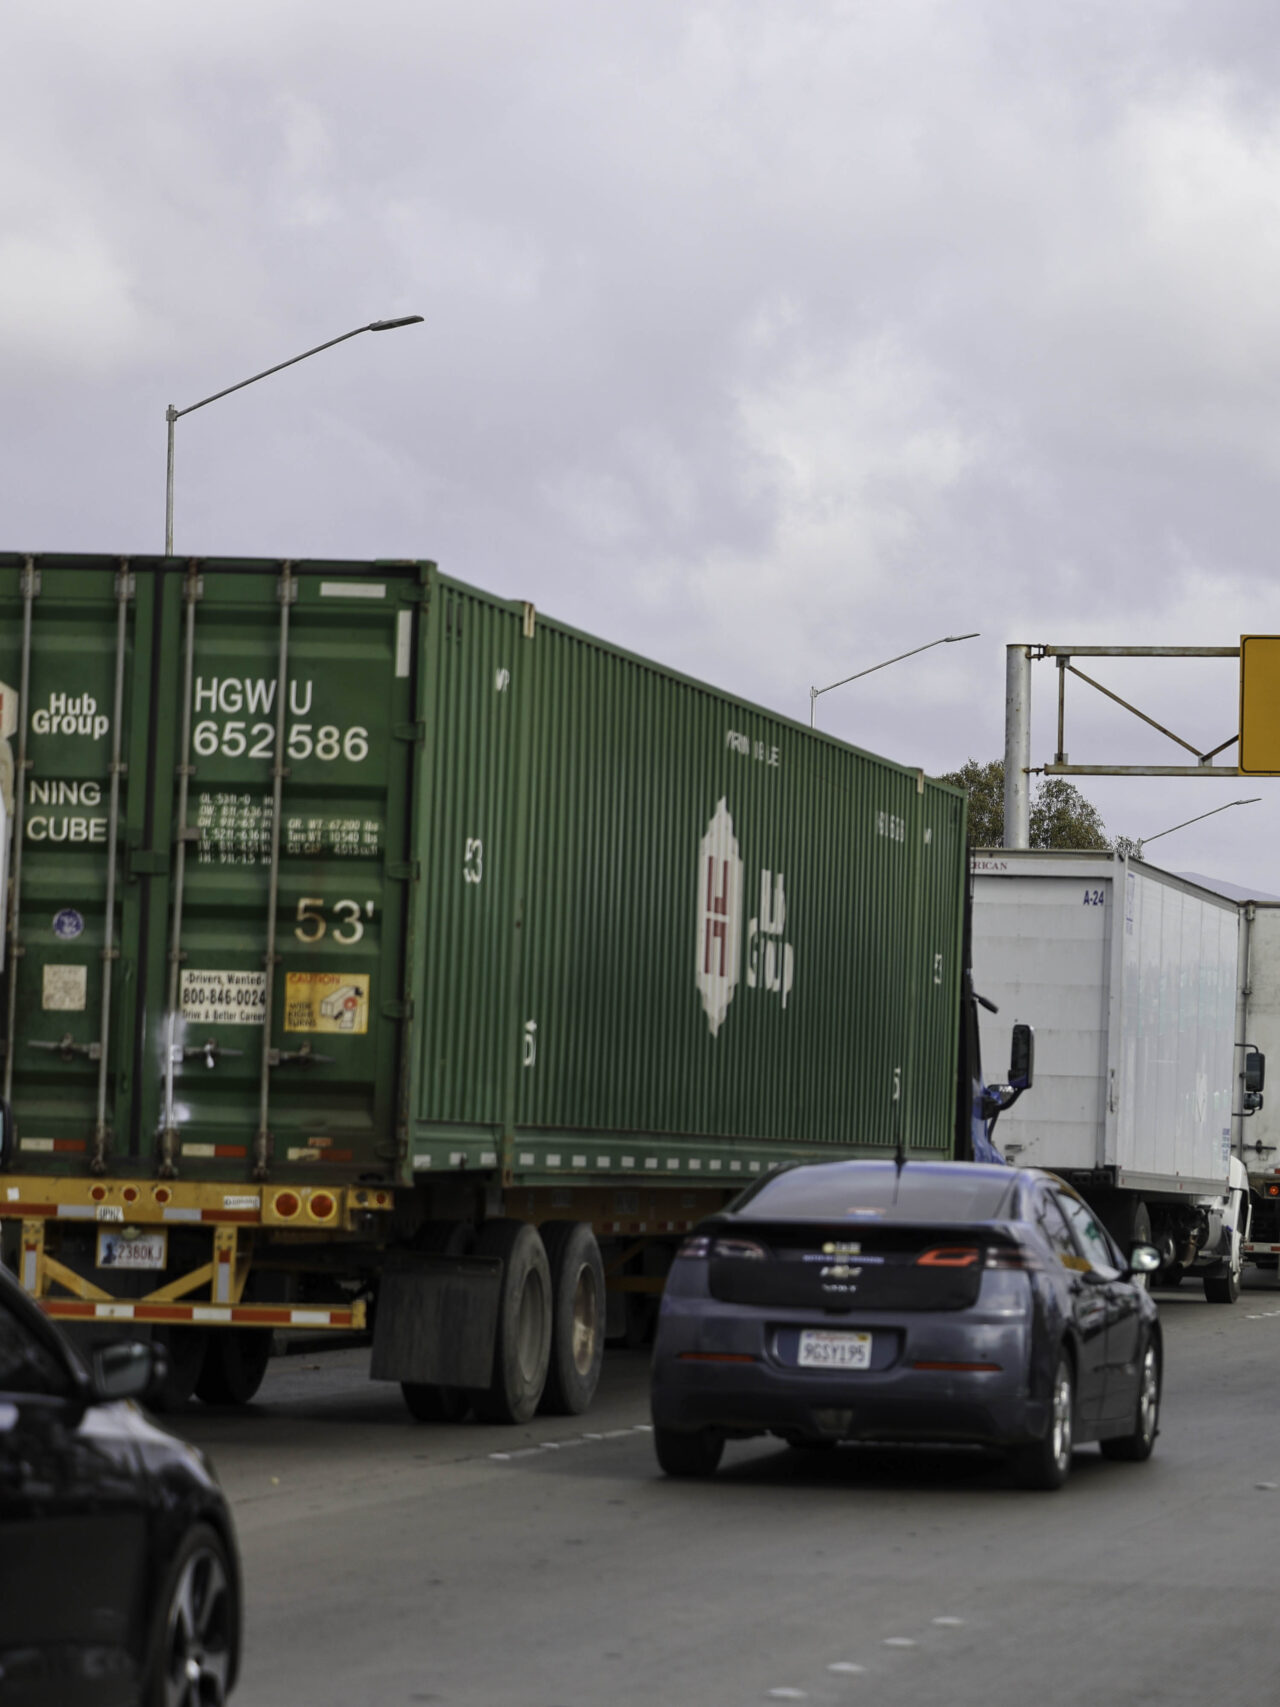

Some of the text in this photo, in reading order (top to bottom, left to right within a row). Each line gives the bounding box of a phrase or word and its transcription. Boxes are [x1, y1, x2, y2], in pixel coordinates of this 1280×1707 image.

[50, 692, 97, 716] Hub
[32, 709, 109, 741] Group
[30, 780, 102, 806] NING
[26, 816, 107, 842] CUBE
[1083, 890, 1104, 906] A-24
[295, 897, 375, 944] 53'
[289, 973, 341, 985] CAUTION
[183, 988, 266, 1006] 800-846-0024
